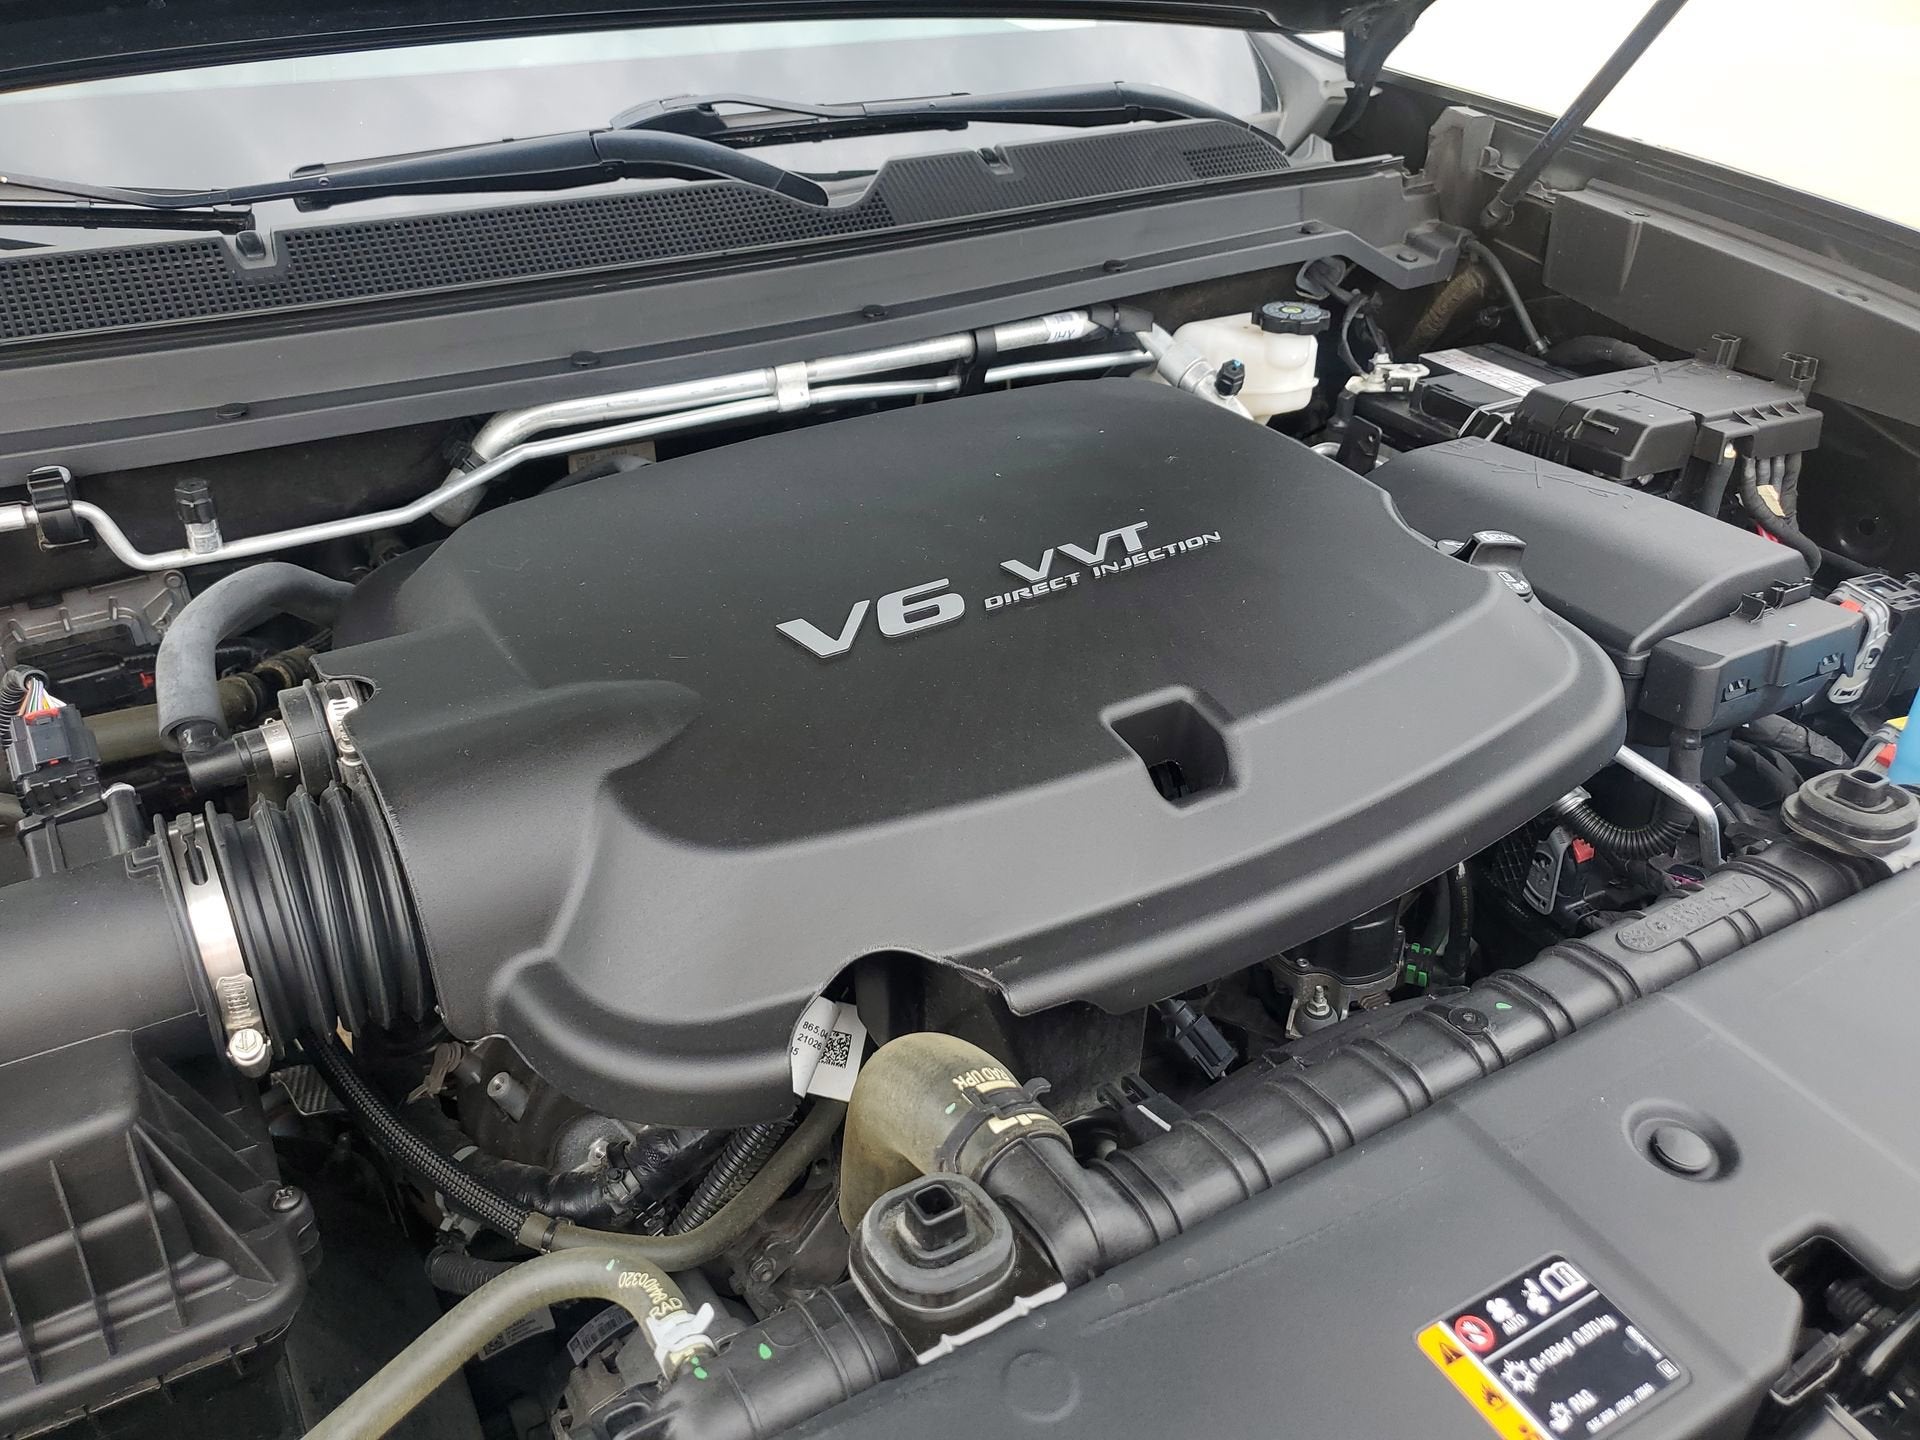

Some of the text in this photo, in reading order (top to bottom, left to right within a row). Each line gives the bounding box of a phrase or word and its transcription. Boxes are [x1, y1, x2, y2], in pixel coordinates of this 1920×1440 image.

[984, 531, 1222, 610] DIRECT INJECTION
[1000, 521, 1148, 581] VVT
[776, 578, 966, 658] V6
[649, 1297, 683, 1319] RAD
